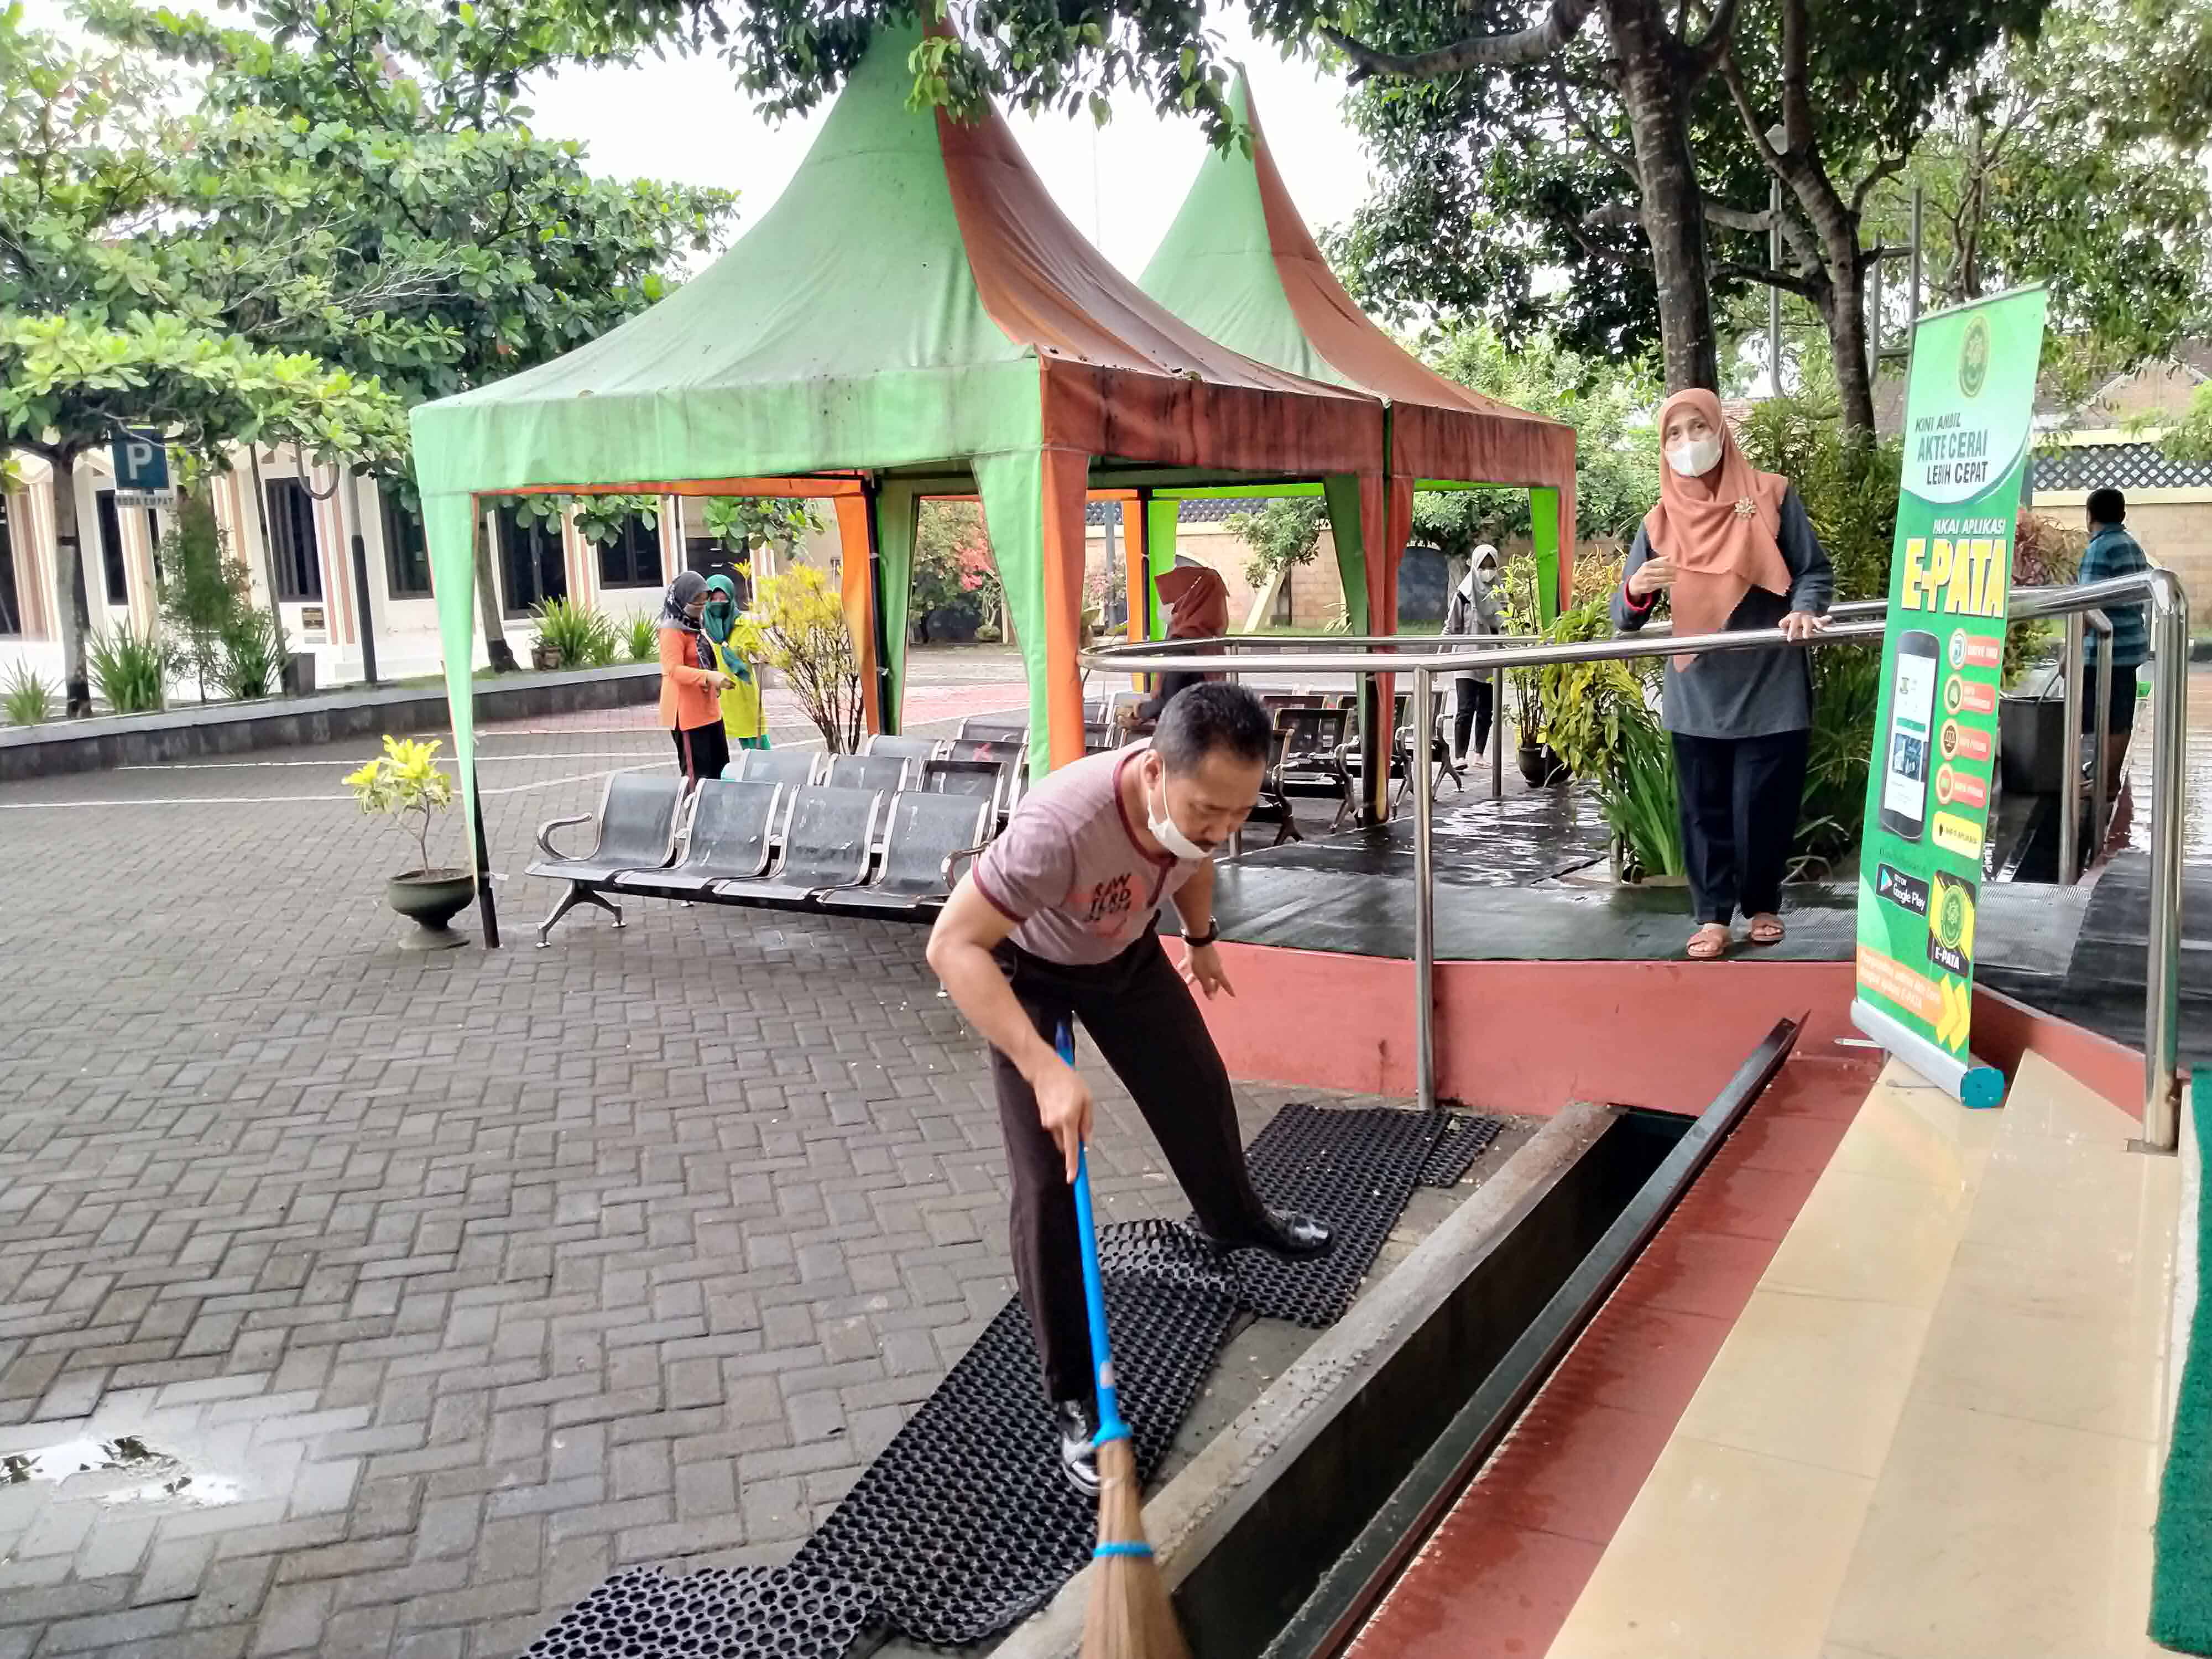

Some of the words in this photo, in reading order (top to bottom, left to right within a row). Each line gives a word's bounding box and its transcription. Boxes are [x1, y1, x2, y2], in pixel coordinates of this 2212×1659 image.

[1917, 435, 1947, 463] AKTE
[1948, 429, 1989, 460] CERAI
[126, 443, 153, 479] P
[1927, 463, 1952, 486] LEBIH
[1954, 461, 1989, 484] CEPAT
[1961, 518, 2006, 535] APLIKASI
[1901, 538, 2008, 619] E-PATA
[1893, 883, 1911, 904] Google
[1912, 891, 1926, 911] Play
[1935, 946, 1959, 969] E-PATA
